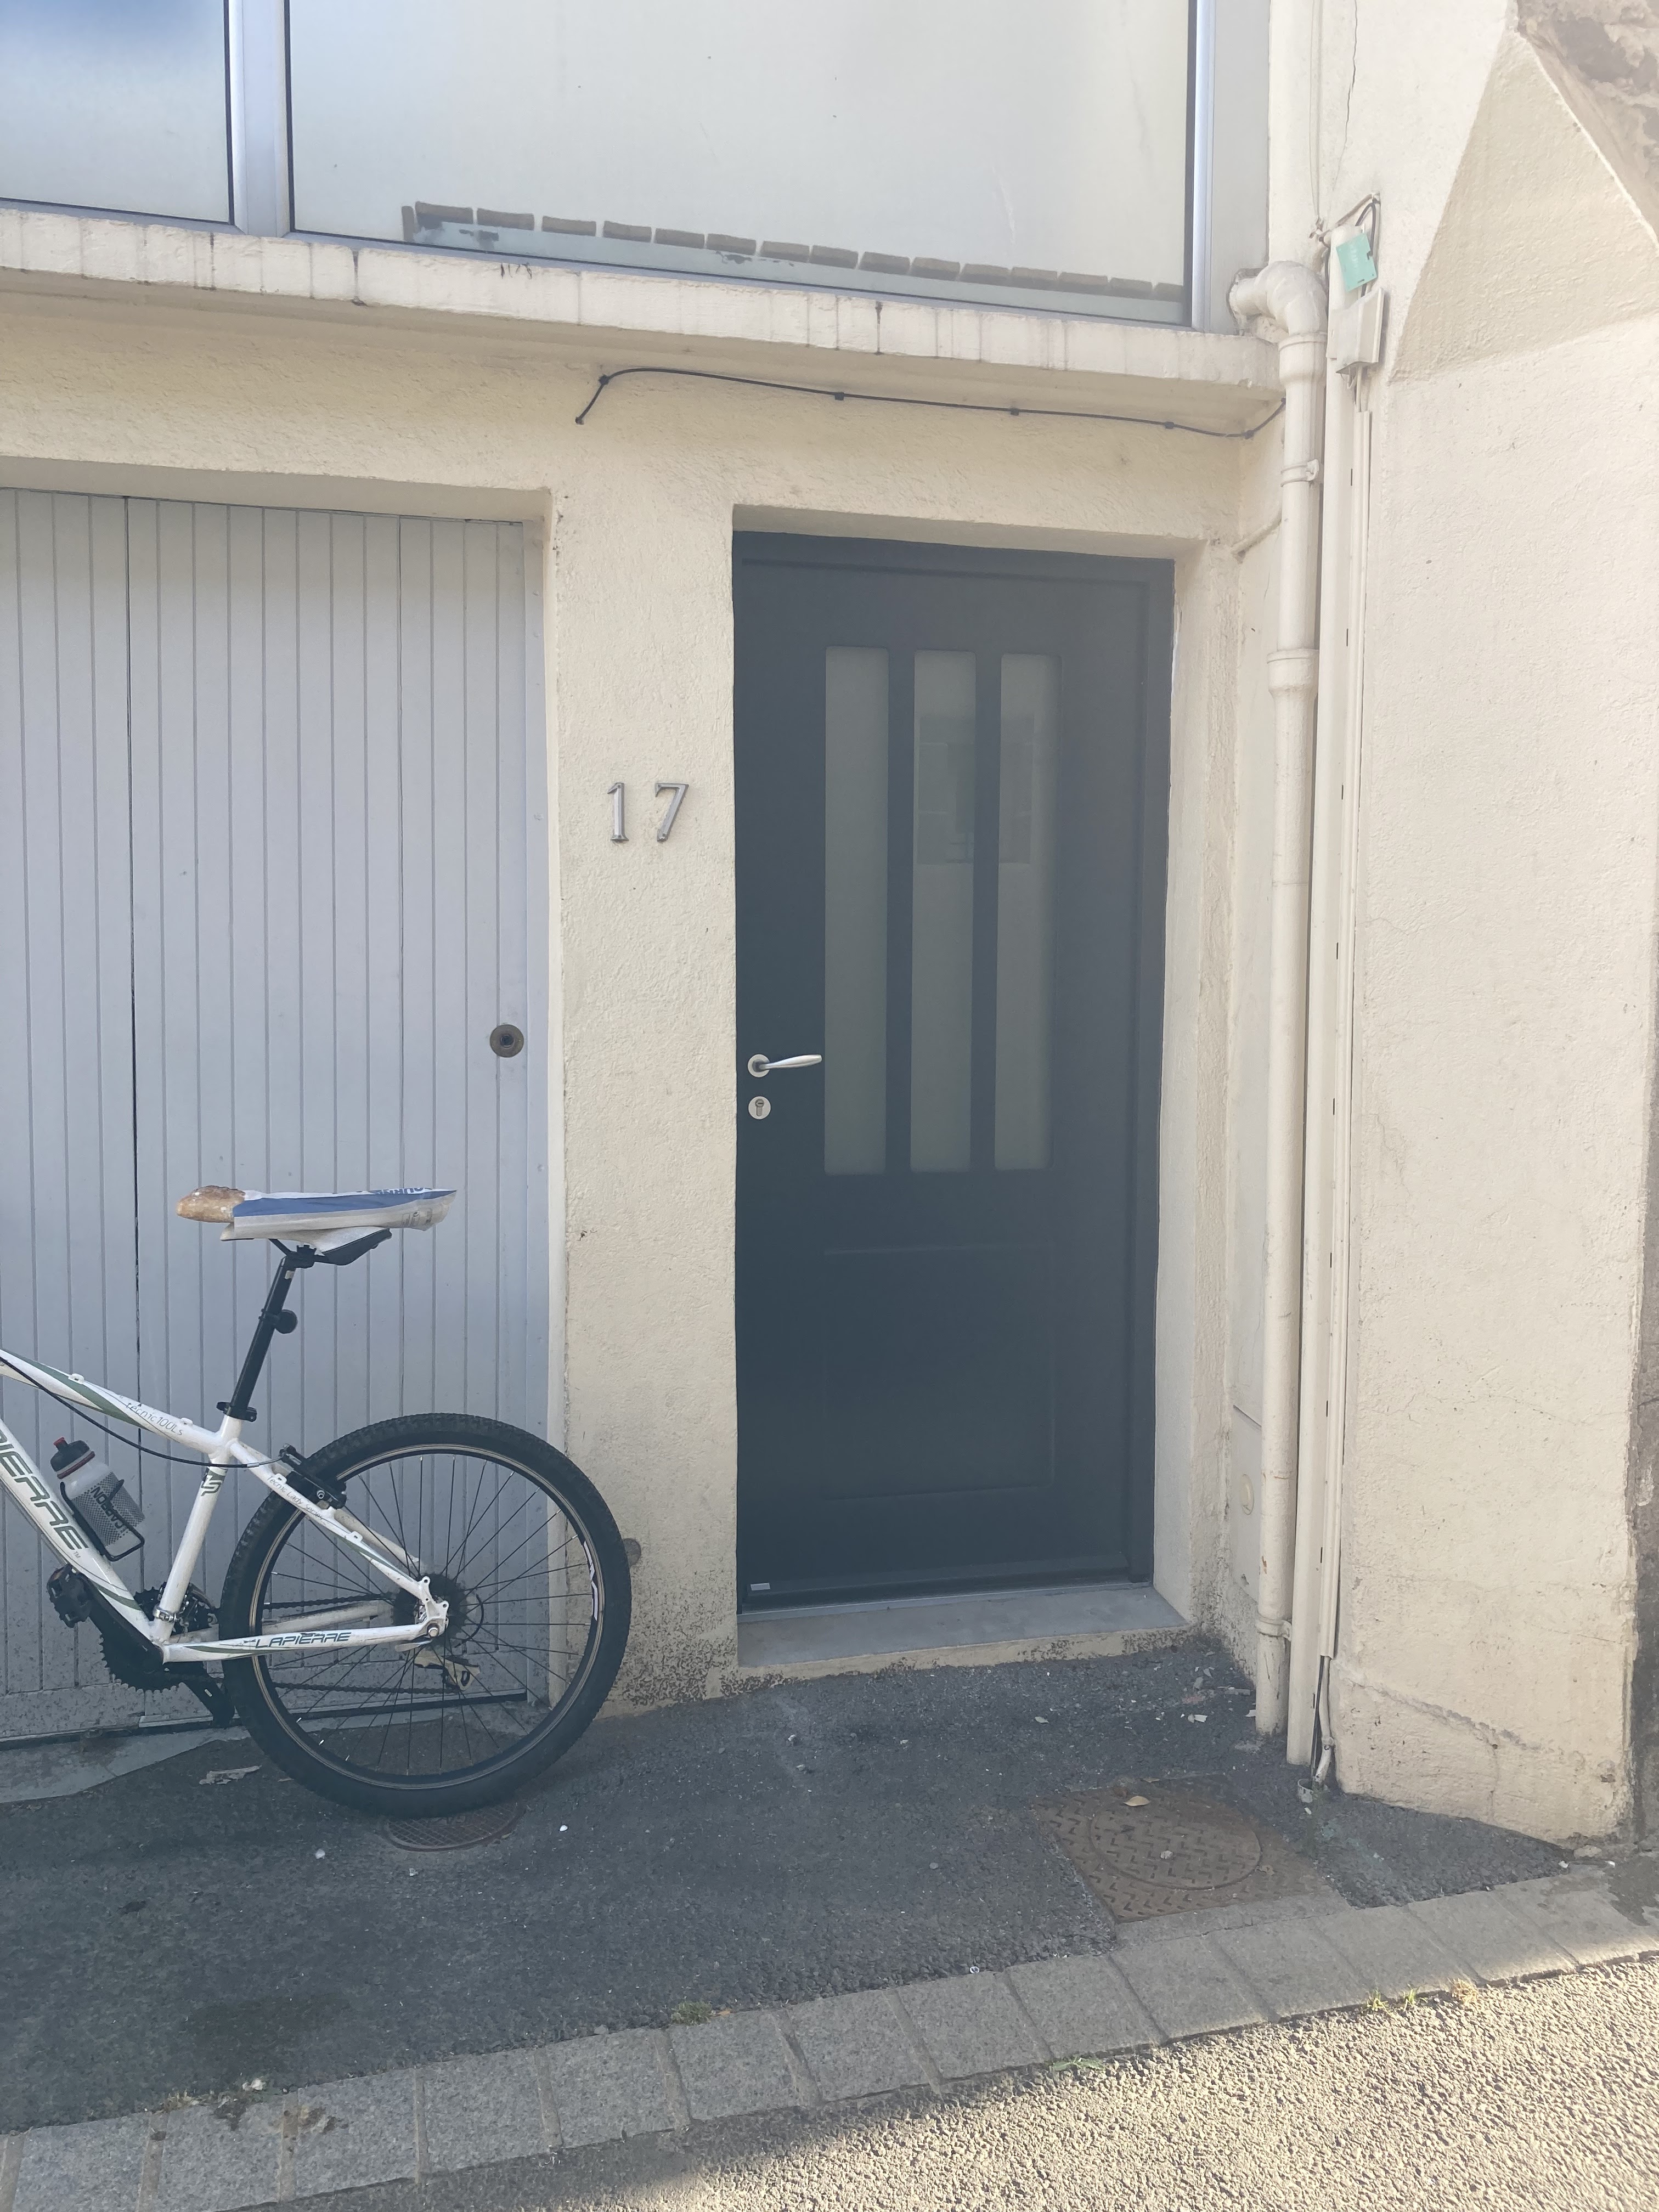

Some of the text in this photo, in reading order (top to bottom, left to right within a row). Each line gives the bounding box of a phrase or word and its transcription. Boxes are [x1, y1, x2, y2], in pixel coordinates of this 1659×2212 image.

[607, 782, 689, 842] 17
[287, 1491, 304, 1506] Lady
[255, 1632, 352, 1649] LAPIERRE
